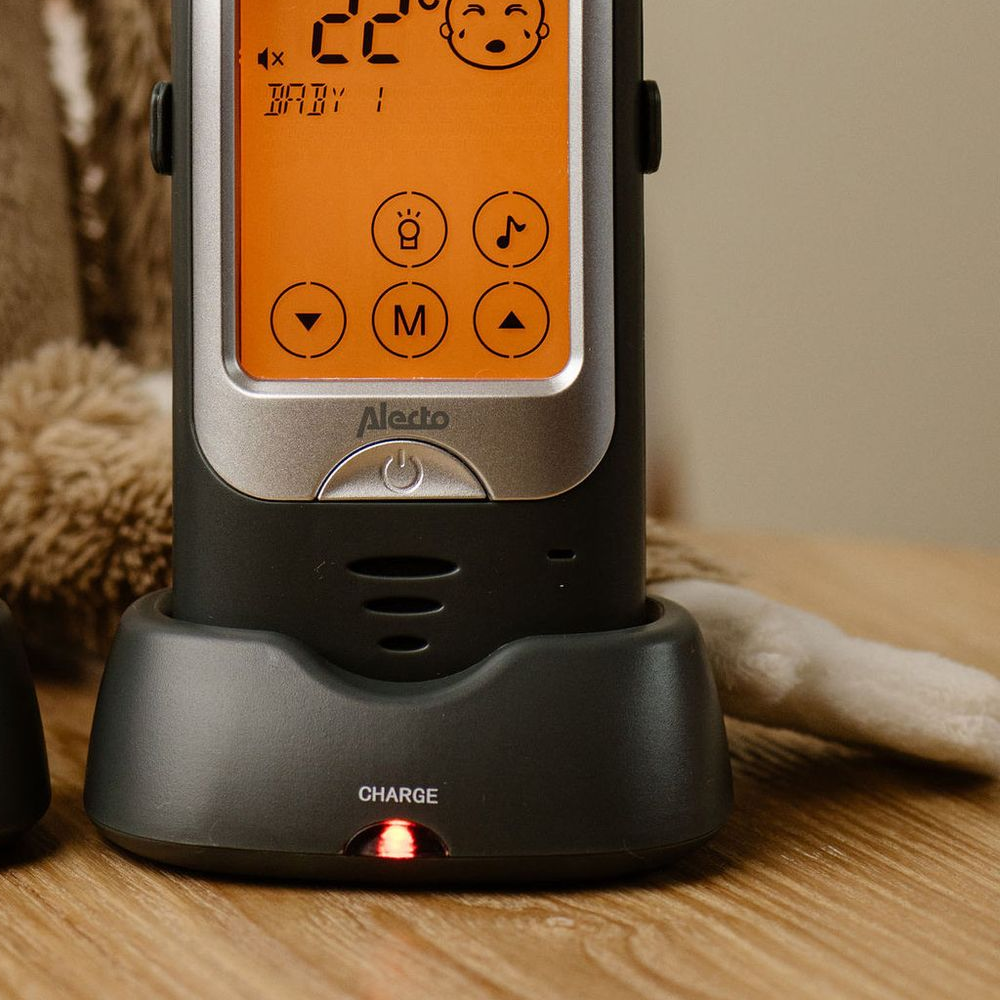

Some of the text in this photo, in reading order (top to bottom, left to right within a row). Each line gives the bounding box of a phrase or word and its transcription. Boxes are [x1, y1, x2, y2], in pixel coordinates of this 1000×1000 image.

[264, 83, 345, 116] BABY
[393, 304, 426, 336] M
[356, 402, 450, 438] Alecto
[358, 785, 439, 804] CHARGE
